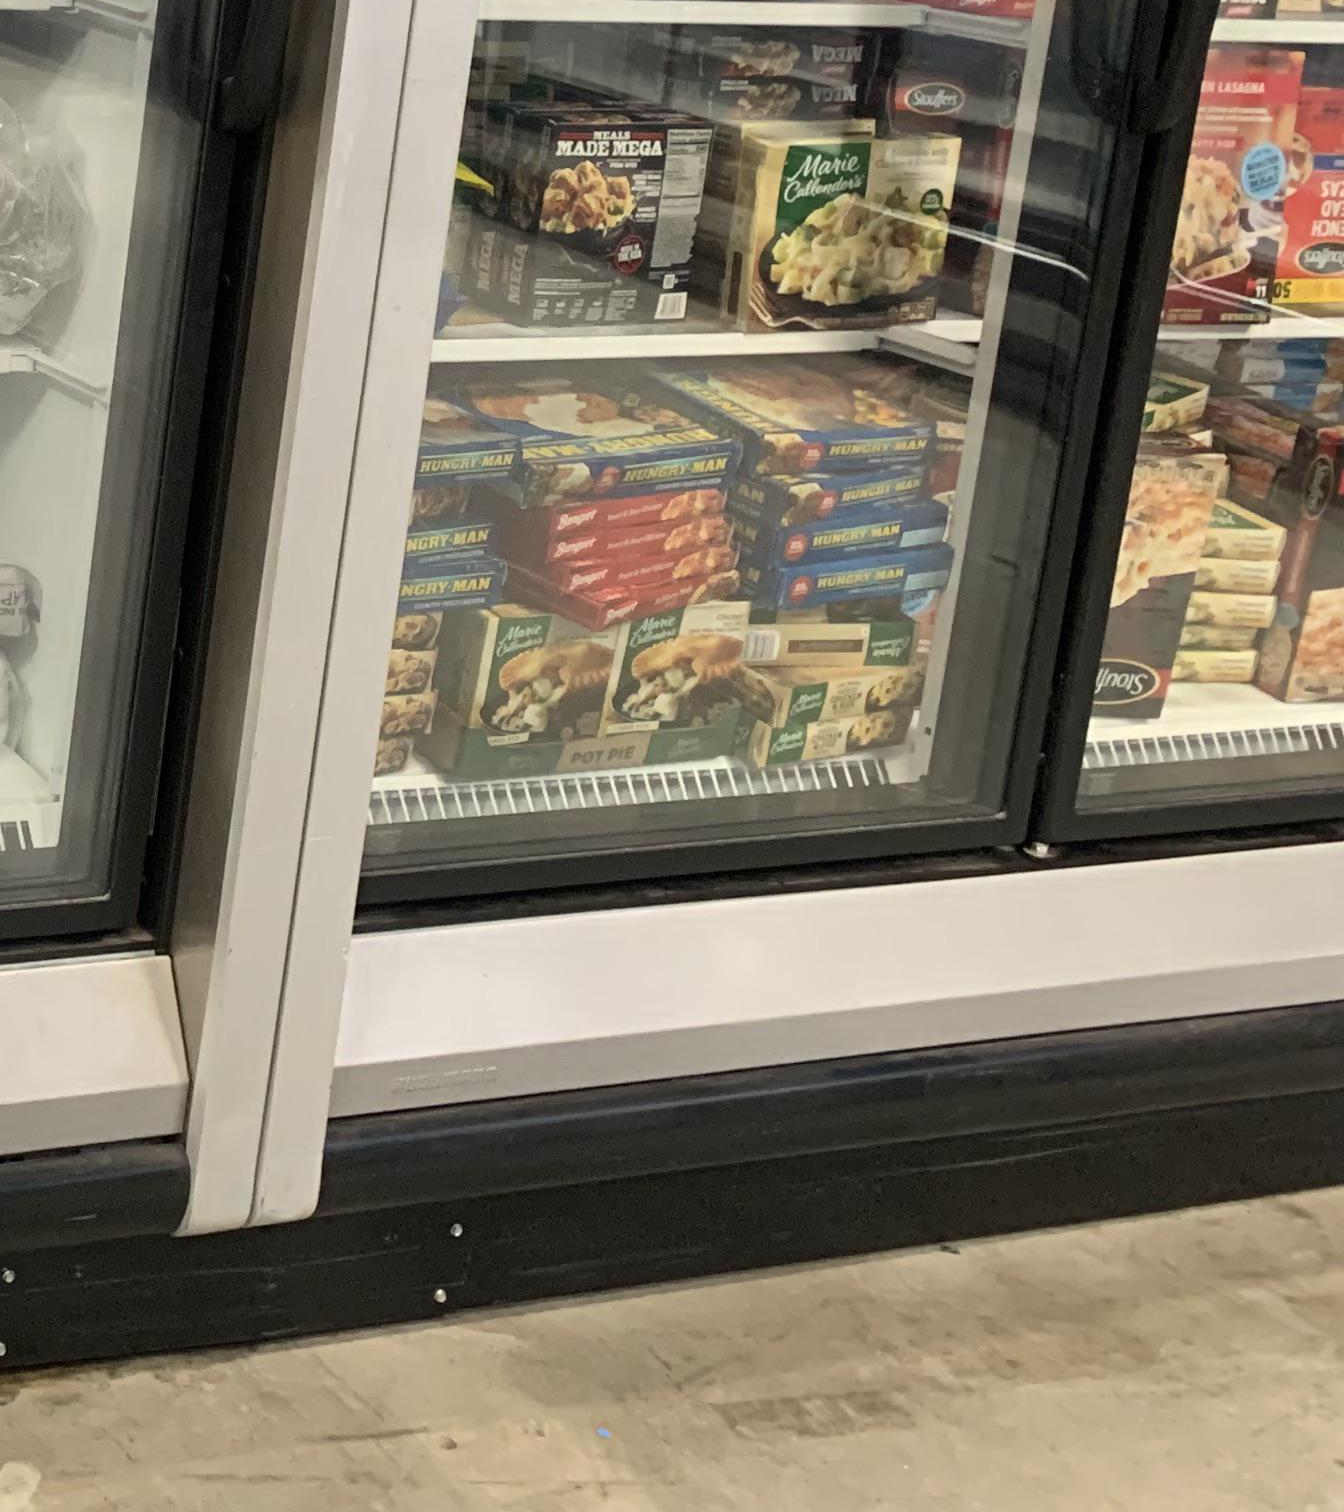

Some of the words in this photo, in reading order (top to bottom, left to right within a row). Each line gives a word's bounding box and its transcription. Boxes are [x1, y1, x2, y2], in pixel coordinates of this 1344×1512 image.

[813, 45, 863, 62] MEGA
[813, 85, 857, 103] MEGA
[1218, 81, 1265, 94] LASAGNA
[593, 131, 631, 140] MEALS
[555, 141, 610, 156] MADE
[613, 140, 663, 156] MEGA
[787, 153, 861, 182] Marie
[784, 175, 864, 203] Callender's
[502, 623, 543, 643] Marie
[636, 615, 676, 636] Marie
[570, 749, 604, 764] POT
[607, 745, 635, 761] PIE
